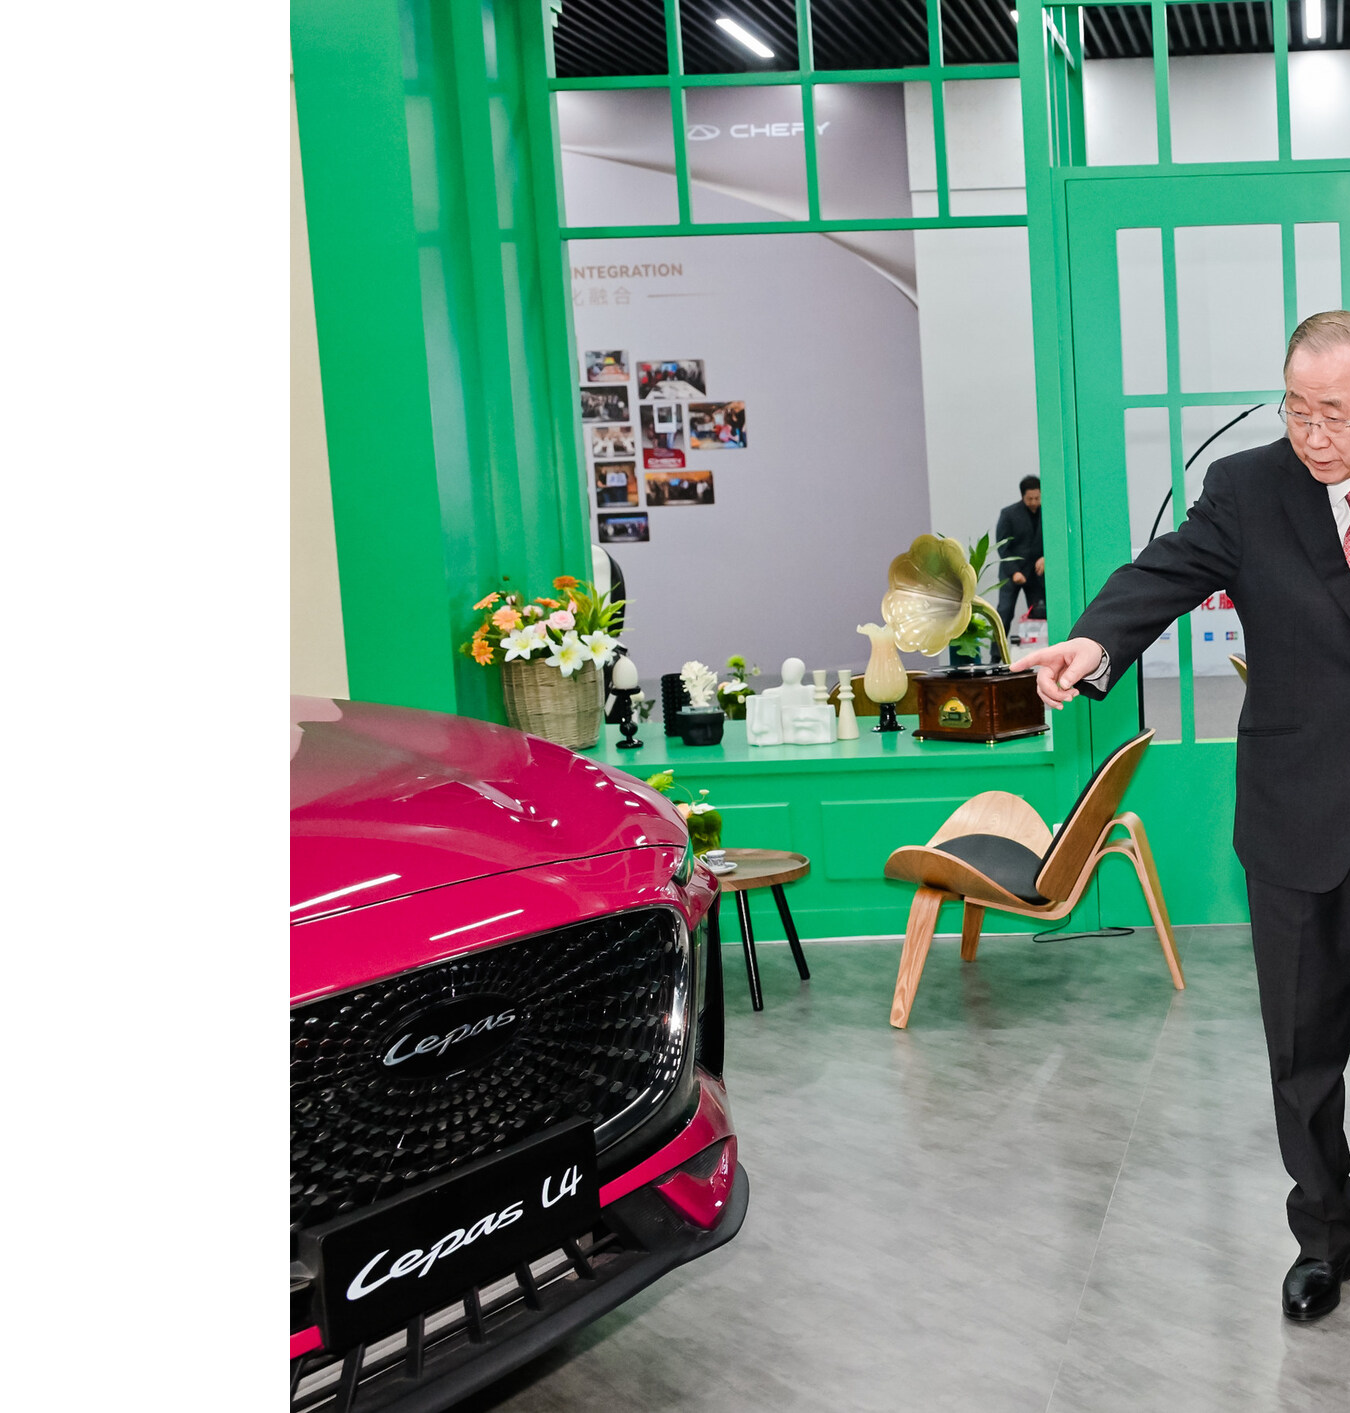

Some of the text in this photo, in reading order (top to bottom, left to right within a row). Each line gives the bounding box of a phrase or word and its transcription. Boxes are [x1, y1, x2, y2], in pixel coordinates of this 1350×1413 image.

[382, 1008, 516, 1067] Lepas
[346, 1164, 583, 1301] Lepas L4
